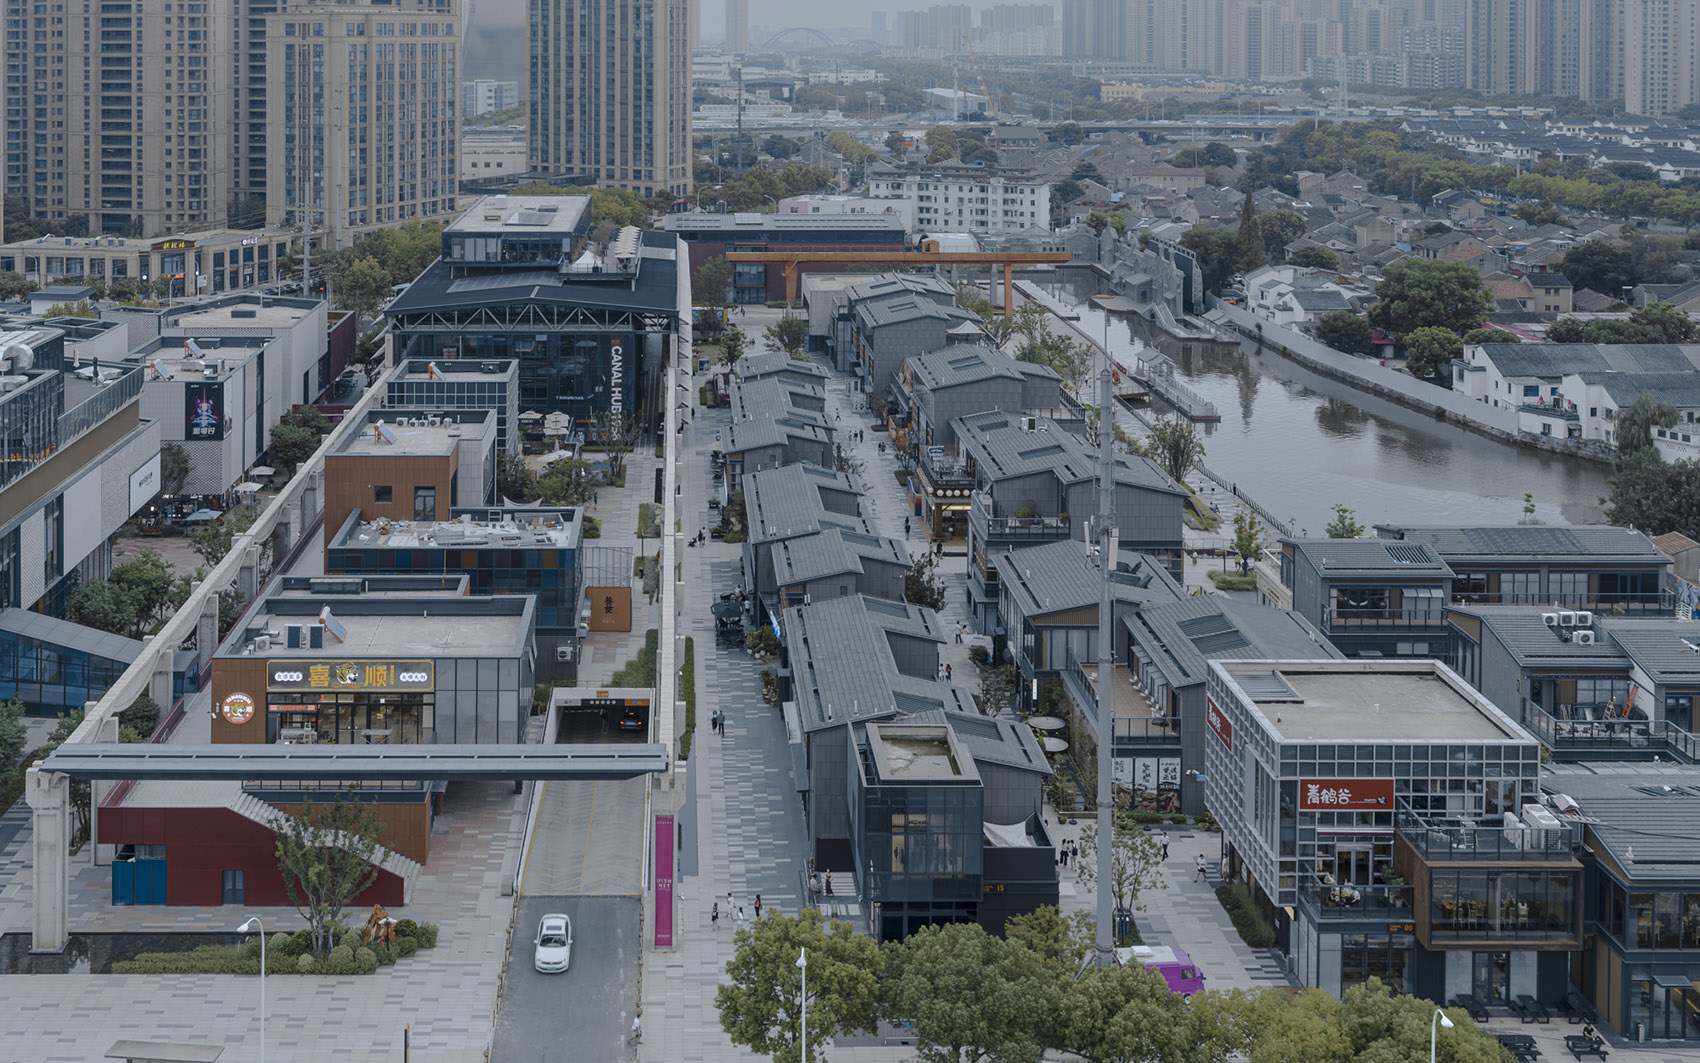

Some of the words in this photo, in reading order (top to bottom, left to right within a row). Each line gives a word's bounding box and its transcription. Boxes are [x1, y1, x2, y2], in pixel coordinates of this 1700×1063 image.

[611, 345, 623, 386] CANAL
[611, 388, 623, 413] HUB
[308, 664, 331, 688] 喜
[363, 665, 388, 688] 顺
[1306, 783, 1353, 805] 青鹤谷
